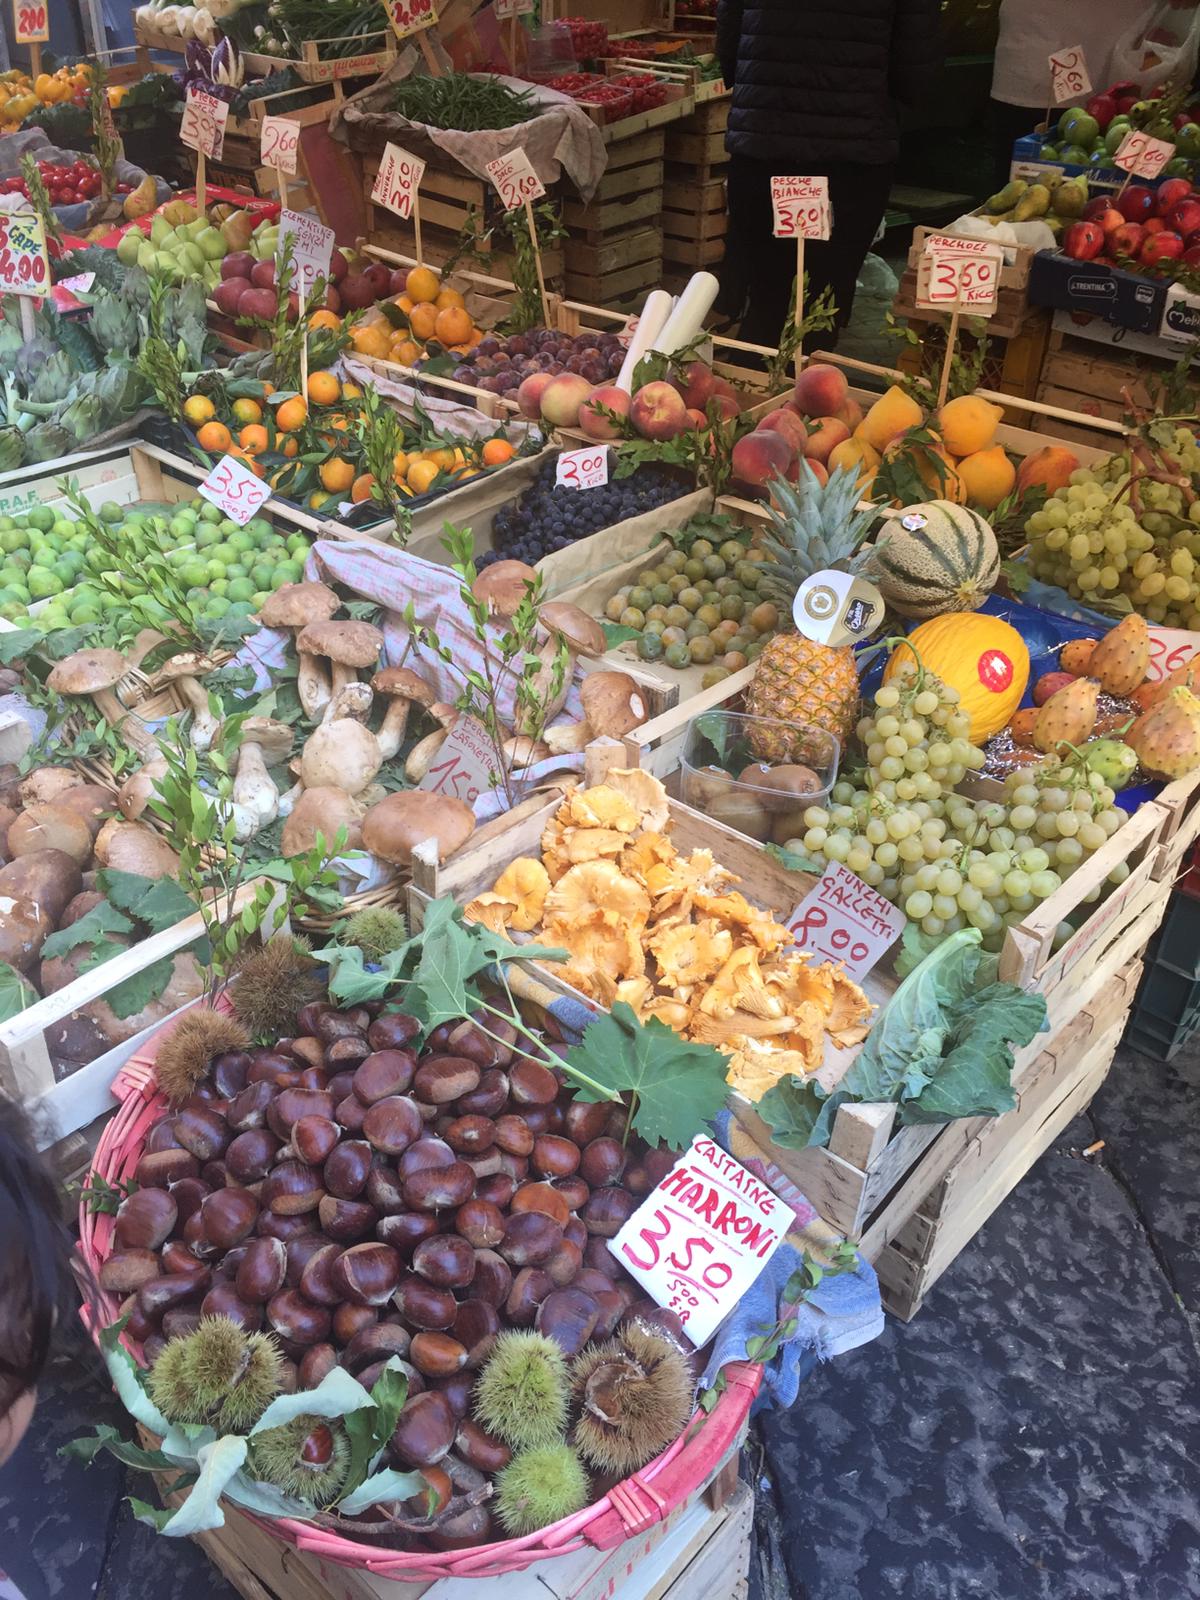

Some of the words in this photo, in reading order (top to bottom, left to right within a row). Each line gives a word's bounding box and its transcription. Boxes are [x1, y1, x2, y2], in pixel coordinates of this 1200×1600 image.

[773, 178, 812, 186] PESCHE
[773, 187, 822, 199] BIANCHE
[659, 1168, 780, 1258] MARRONI
